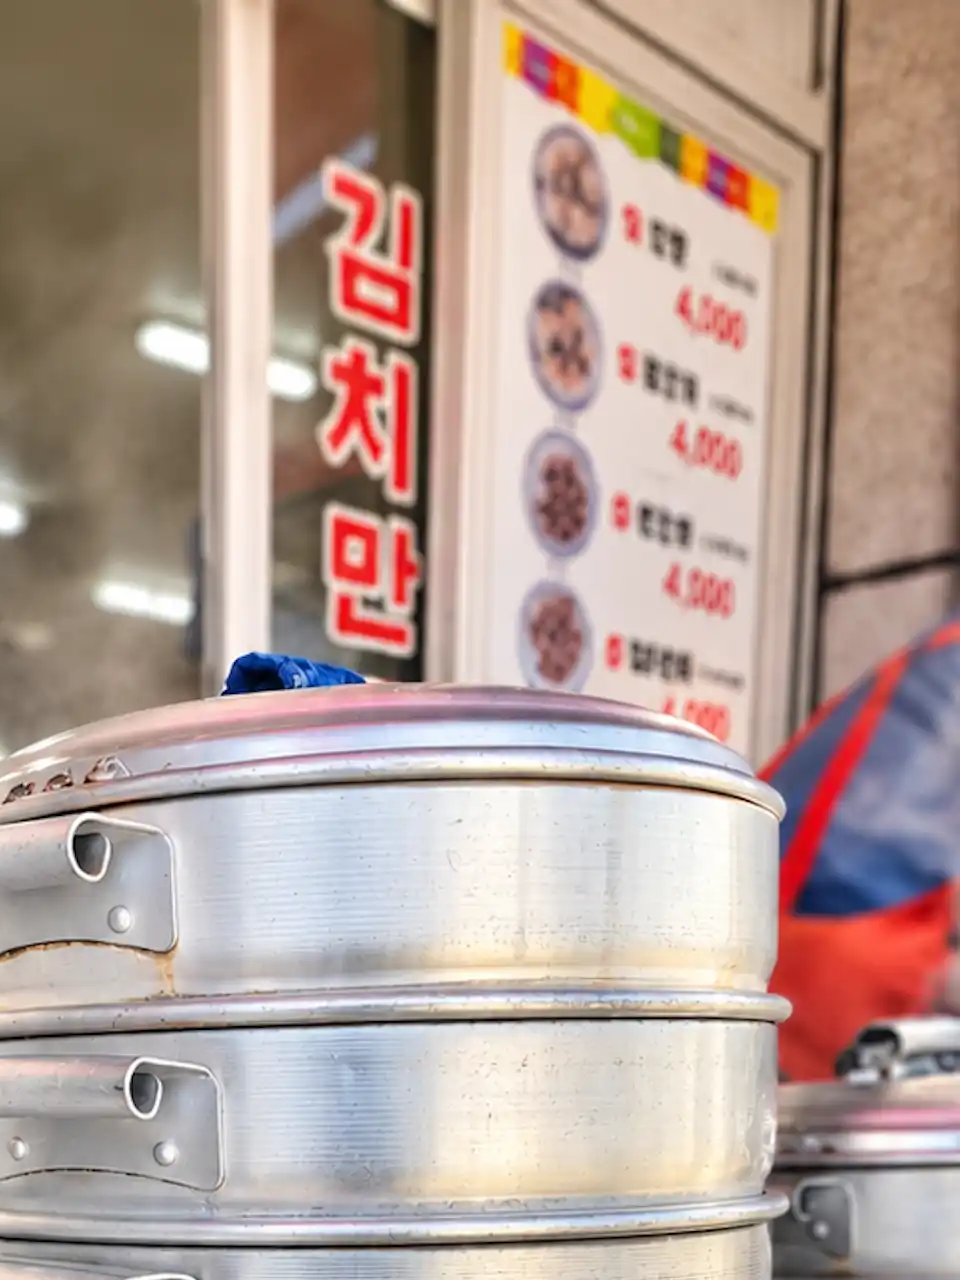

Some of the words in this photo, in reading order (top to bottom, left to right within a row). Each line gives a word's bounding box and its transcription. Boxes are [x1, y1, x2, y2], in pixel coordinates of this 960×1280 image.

[675, 285, 746, 350] 4,000
[670, 420, 742, 480] 4,000
[662, 562, 735, 619] 4,000
[663, 697, 729, 742] 000
